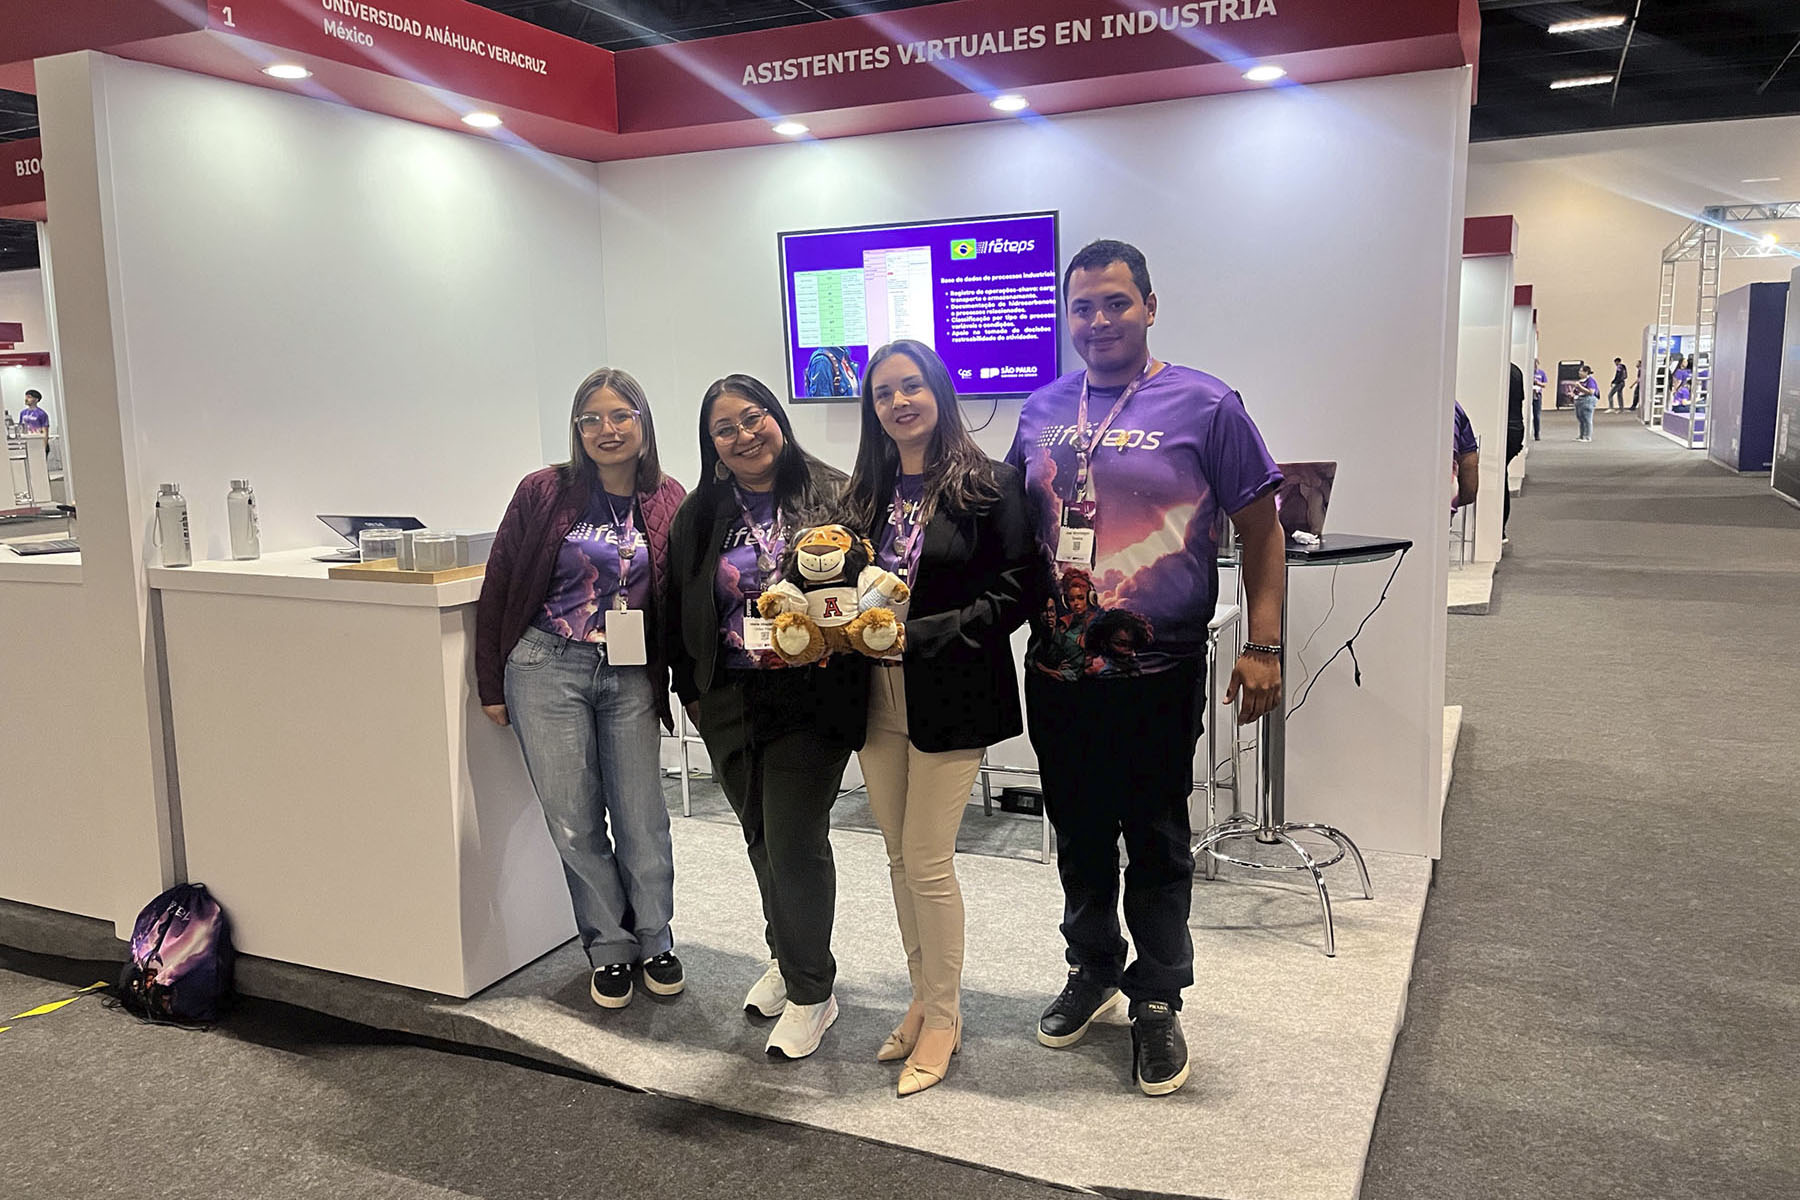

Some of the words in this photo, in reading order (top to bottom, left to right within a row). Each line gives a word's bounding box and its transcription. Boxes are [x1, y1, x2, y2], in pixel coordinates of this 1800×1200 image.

[222, 6, 236, 28] 1
[322, 0, 421, 36] UNIVERSIDAD
[425, 26, 486, 56] ANÁHUAC
[487, 43, 547, 75] VERACRUZ
[323, 18, 374, 47] México
[742, 46, 890, 86] ASISTENTES
[897, 25, 1046, 65] VIRTUALES
[1055, 18, 1091, 46] EN
[1101, 0, 1277, 39] INDUSTRIA
[16, 158, 42, 176] BIO
[824, 597, 842, 618] A
